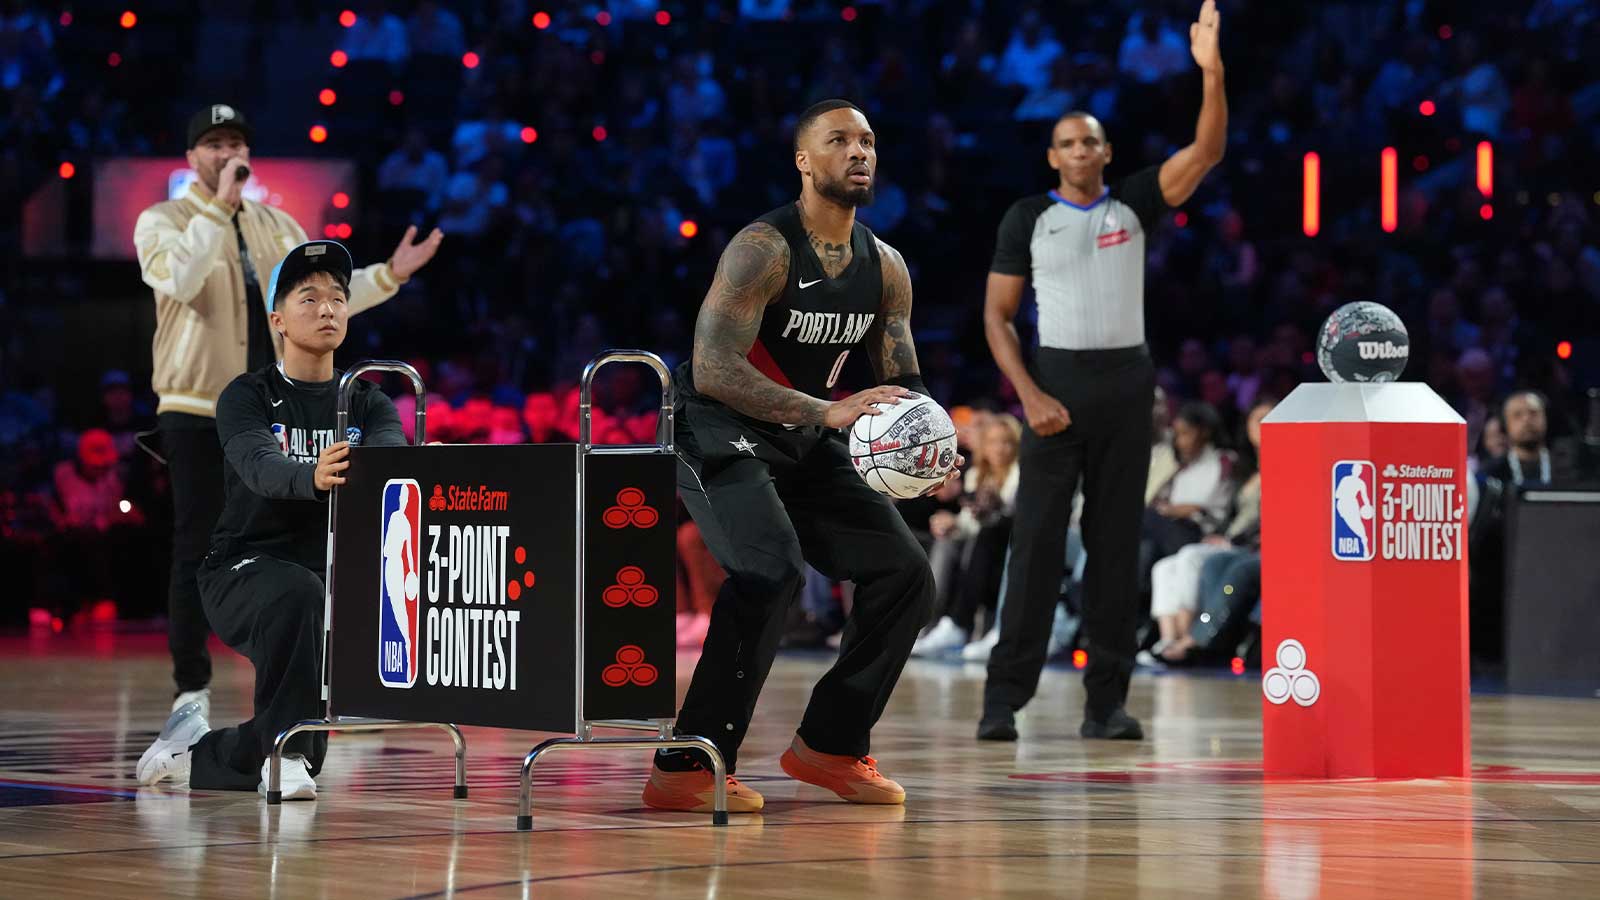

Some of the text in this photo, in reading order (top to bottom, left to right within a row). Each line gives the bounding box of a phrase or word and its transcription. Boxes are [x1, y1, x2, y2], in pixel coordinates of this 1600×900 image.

[825, 349, 850, 389] 0
[312, 429, 337, 457] STA
[1382, 482, 1456, 521] 3-POINT
[1338, 537, 1361, 554] NBA
[1382, 521, 1462, 561] CONTEST
[427, 524, 510, 605] 3-POINT
[384, 640, 403, 673] NBA
[426, 606, 521, 690] CONTEST
